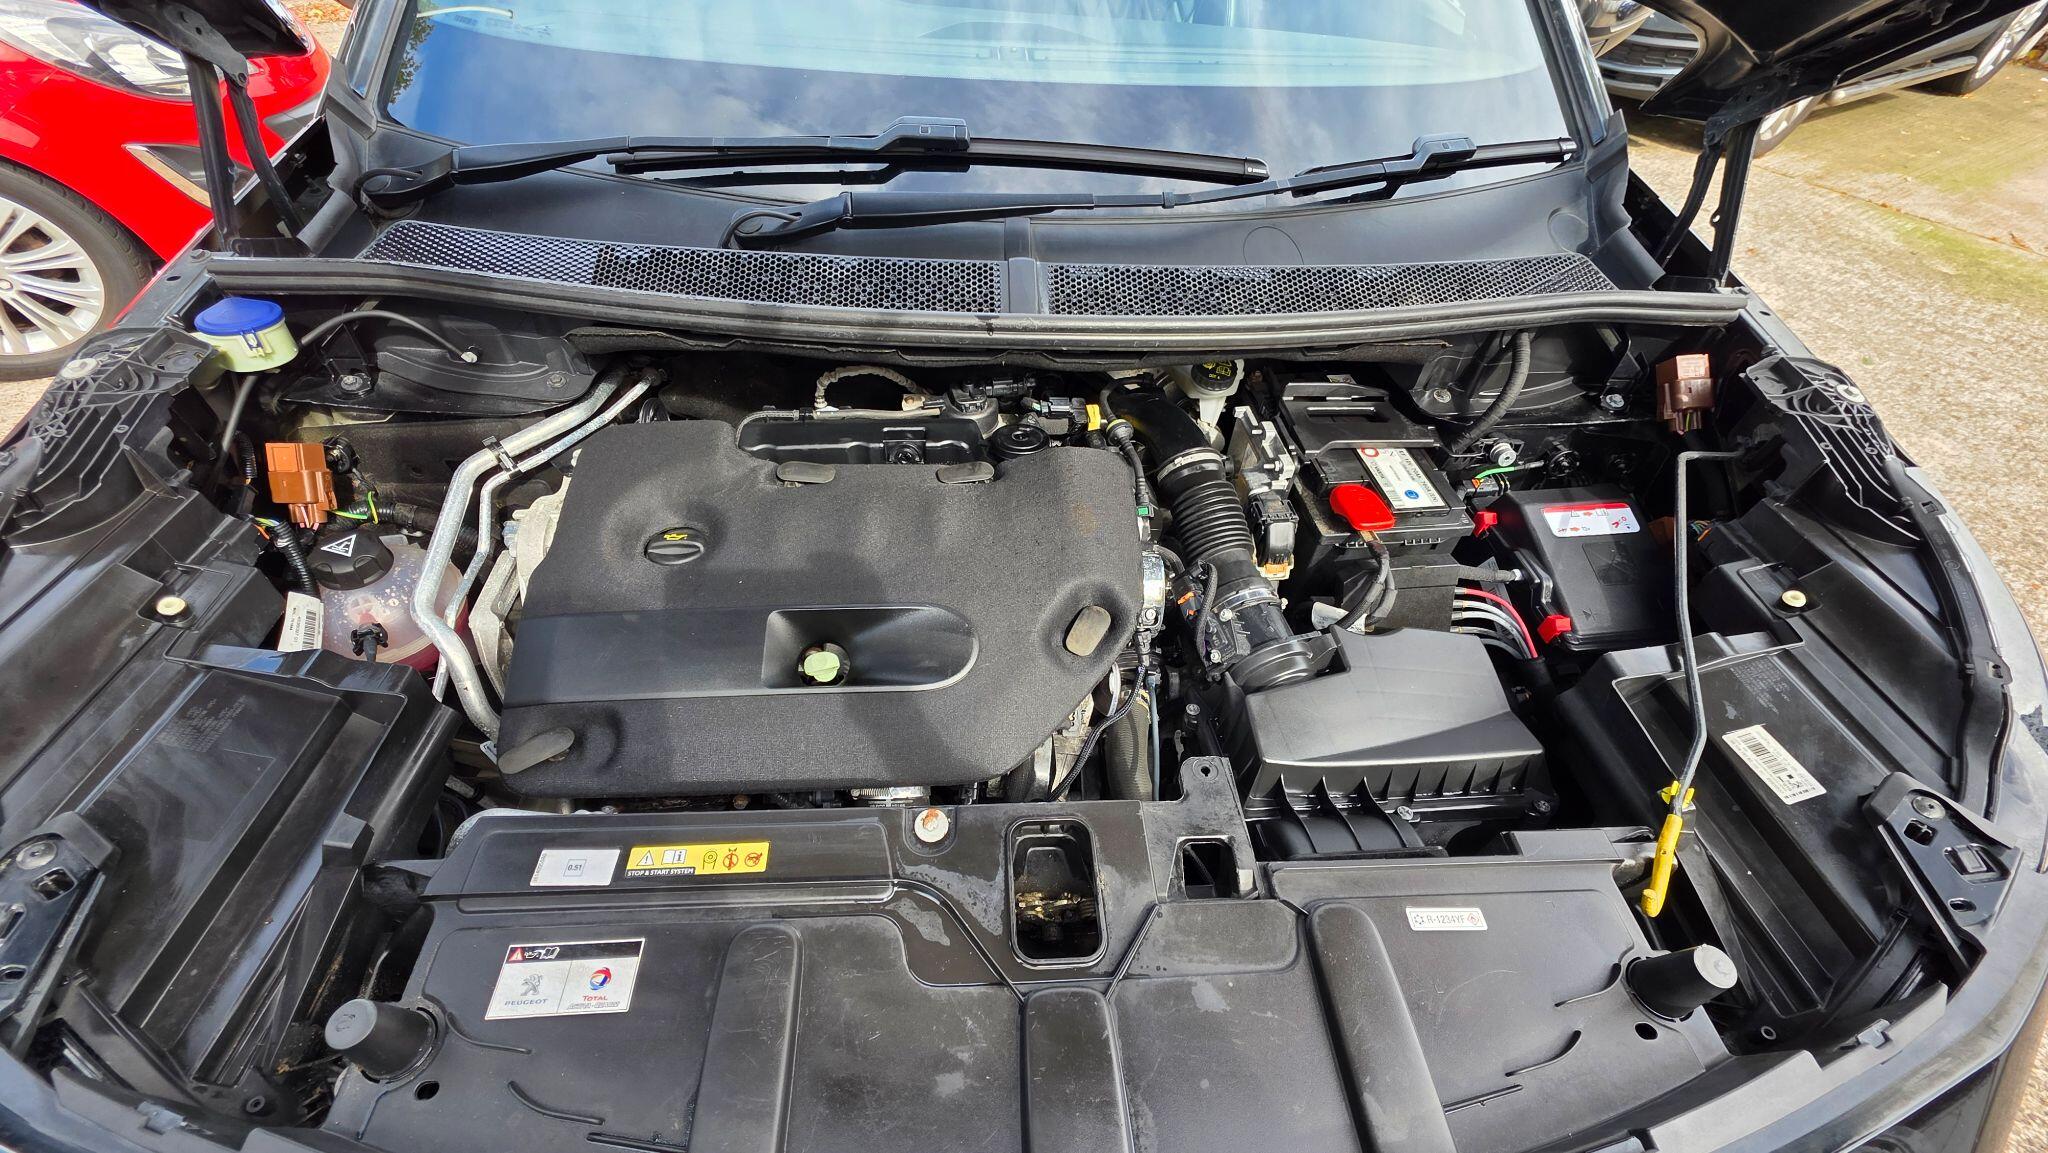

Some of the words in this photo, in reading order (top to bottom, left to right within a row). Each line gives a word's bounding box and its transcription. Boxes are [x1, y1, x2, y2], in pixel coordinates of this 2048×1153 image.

[567, 864, 582, 872] 0.51
[650, 868, 670, 876] START
[670, 867, 694, 875] SYSTEM
[1426, 914, 1465, 925] R-1234YF
[504, 998, 549, 1006] PEUGEOT
